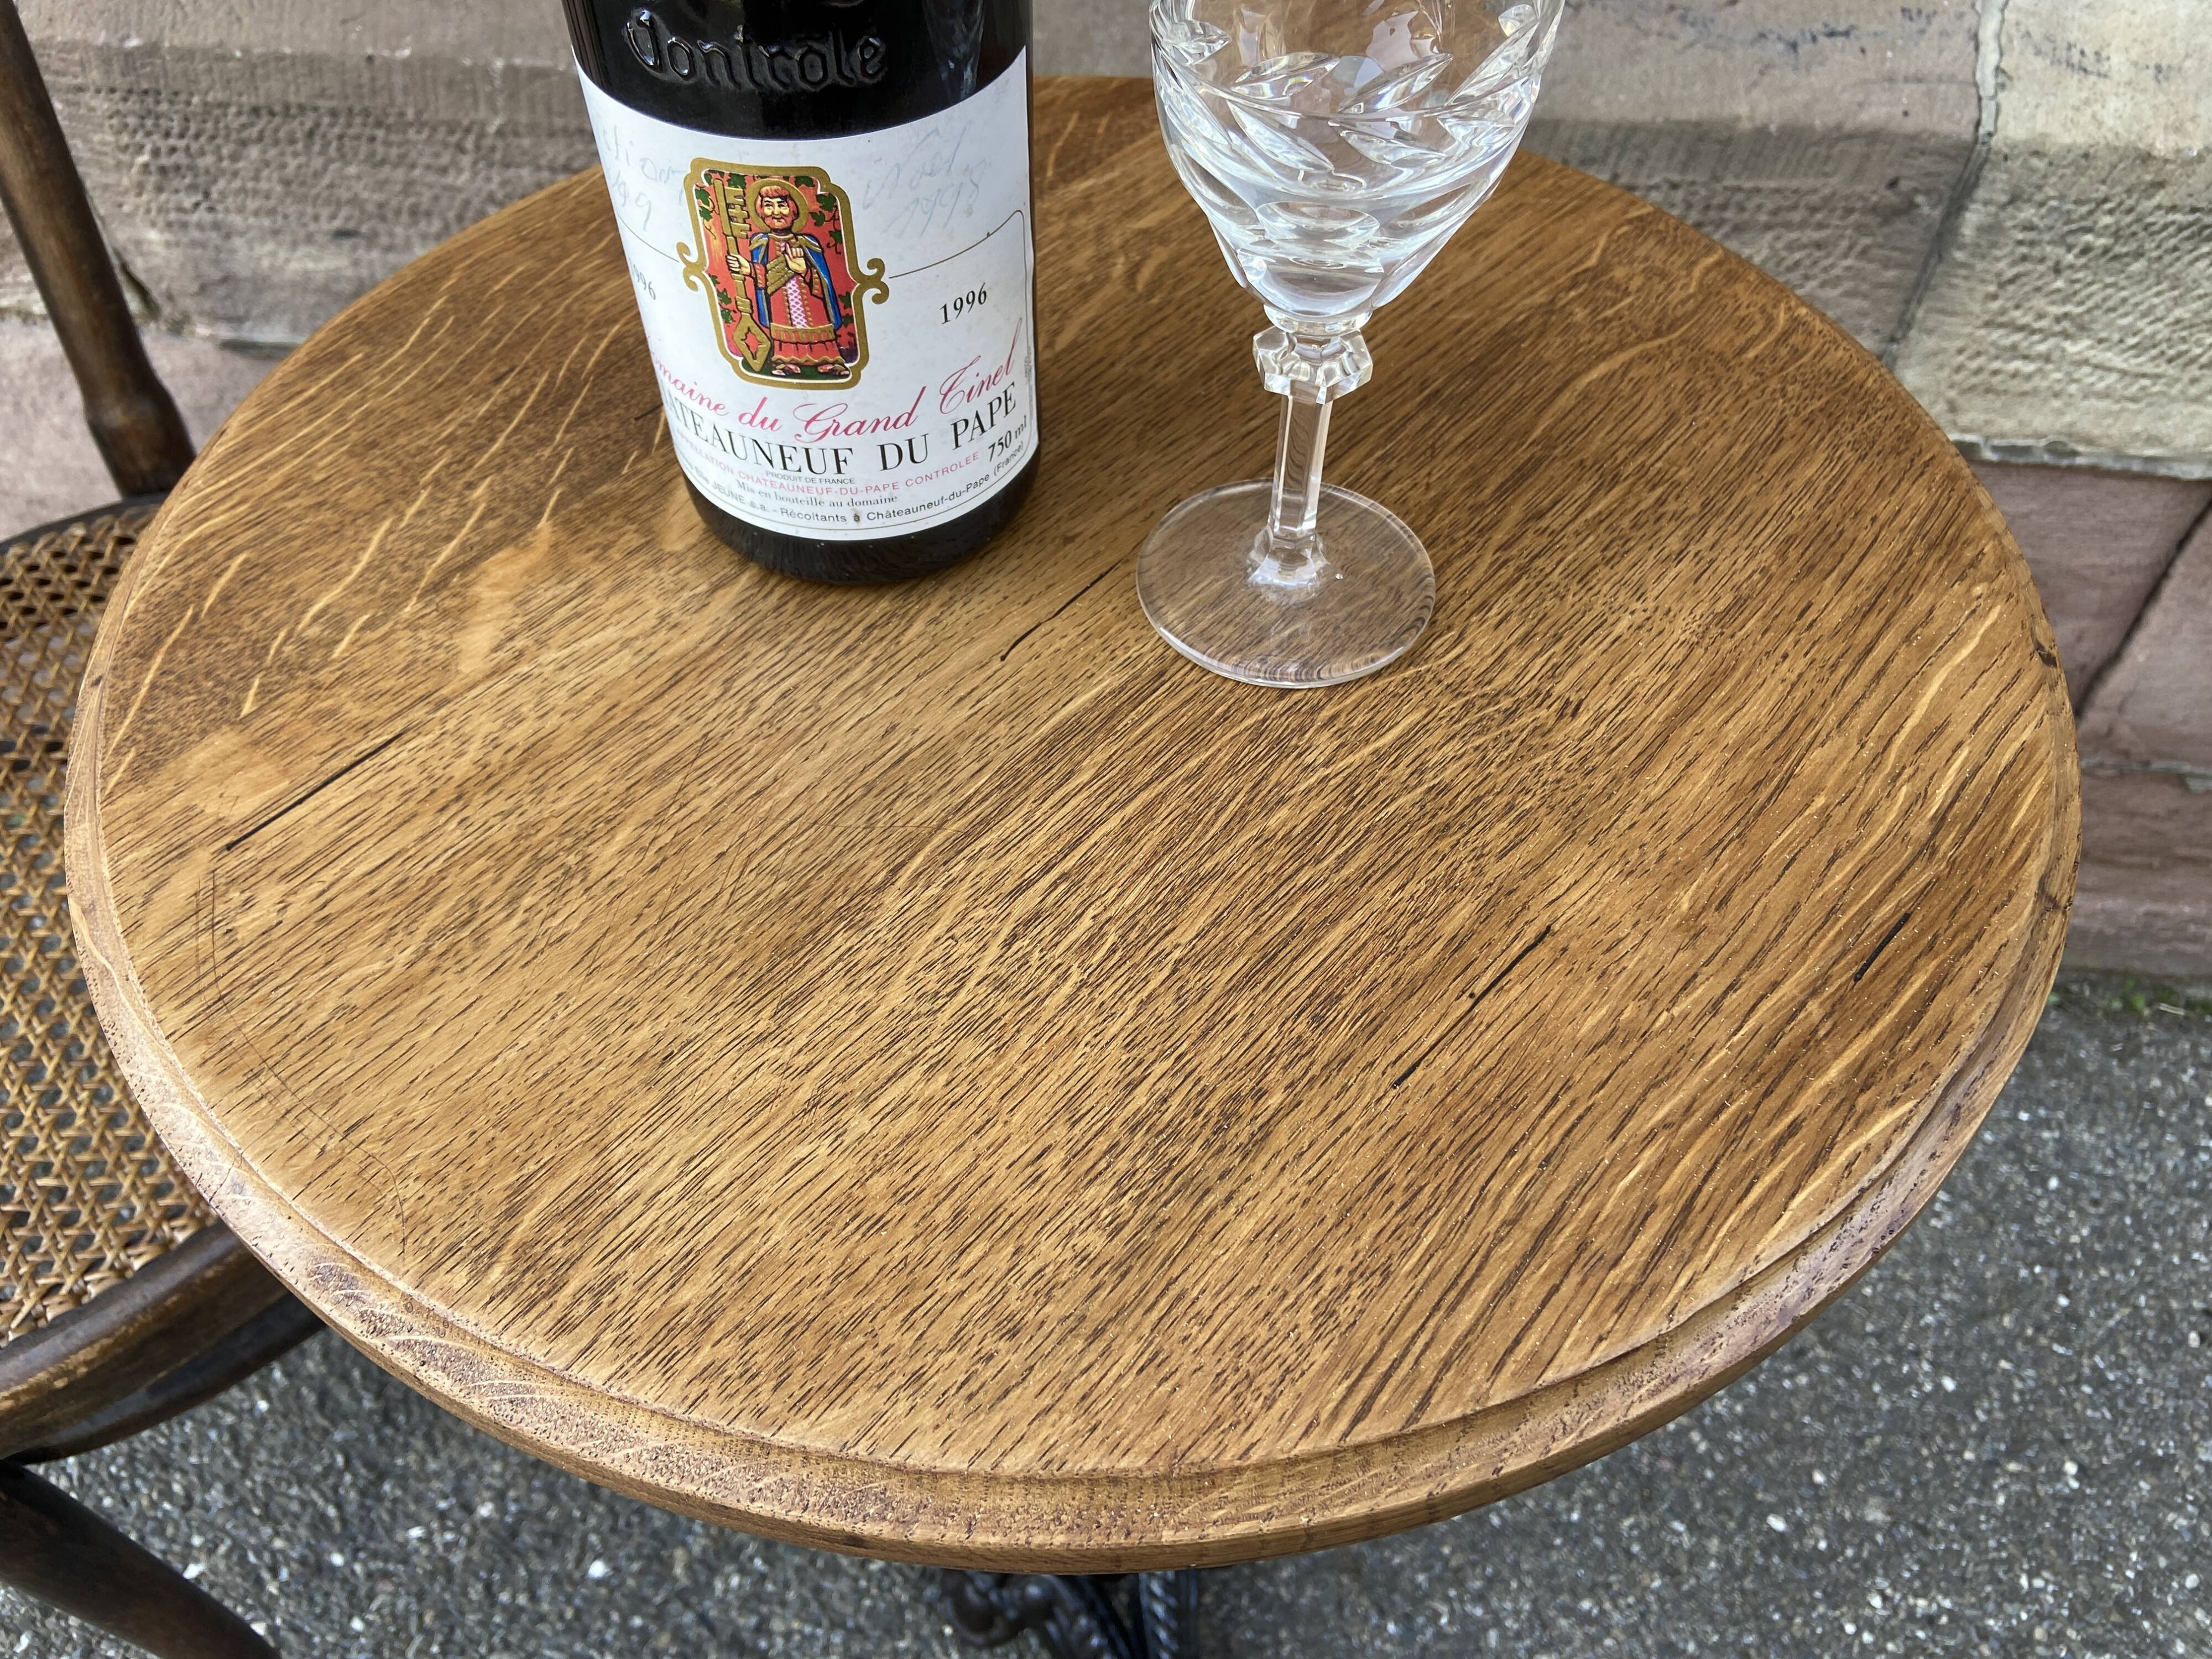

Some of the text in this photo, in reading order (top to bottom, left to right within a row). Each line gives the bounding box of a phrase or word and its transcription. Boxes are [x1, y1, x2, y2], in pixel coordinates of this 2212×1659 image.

[940, 282, 987, 325] 1996
[738, 397, 782, 432] du
[792, 385, 927, 443] Grand
[938, 317, 1022, 415] Tinel
[877, 434, 929, 472] DU
[950, 381, 1016, 450] PAPE
[988, 414, 1027, 462] 750 ml
[712, 481, 746, 504] JEUNE
[780, 507, 847, 523] Récoltants
[866, 473, 990, 521] Châteauneuf-du-Pape
[993, 441, 1024, 476] (France)
[737, 479, 755, 495] Mis
[758, 490, 771, 499] en
[774, 492, 825, 507] bouteille
[847, 493, 898, 507] domaine
[738, 470, 900, 495] CHATEAUNEUF-DU-PAPE
[905, 451, 979, 487] CONTROLEE
[765, 471, 802, 482] PRODUIT
